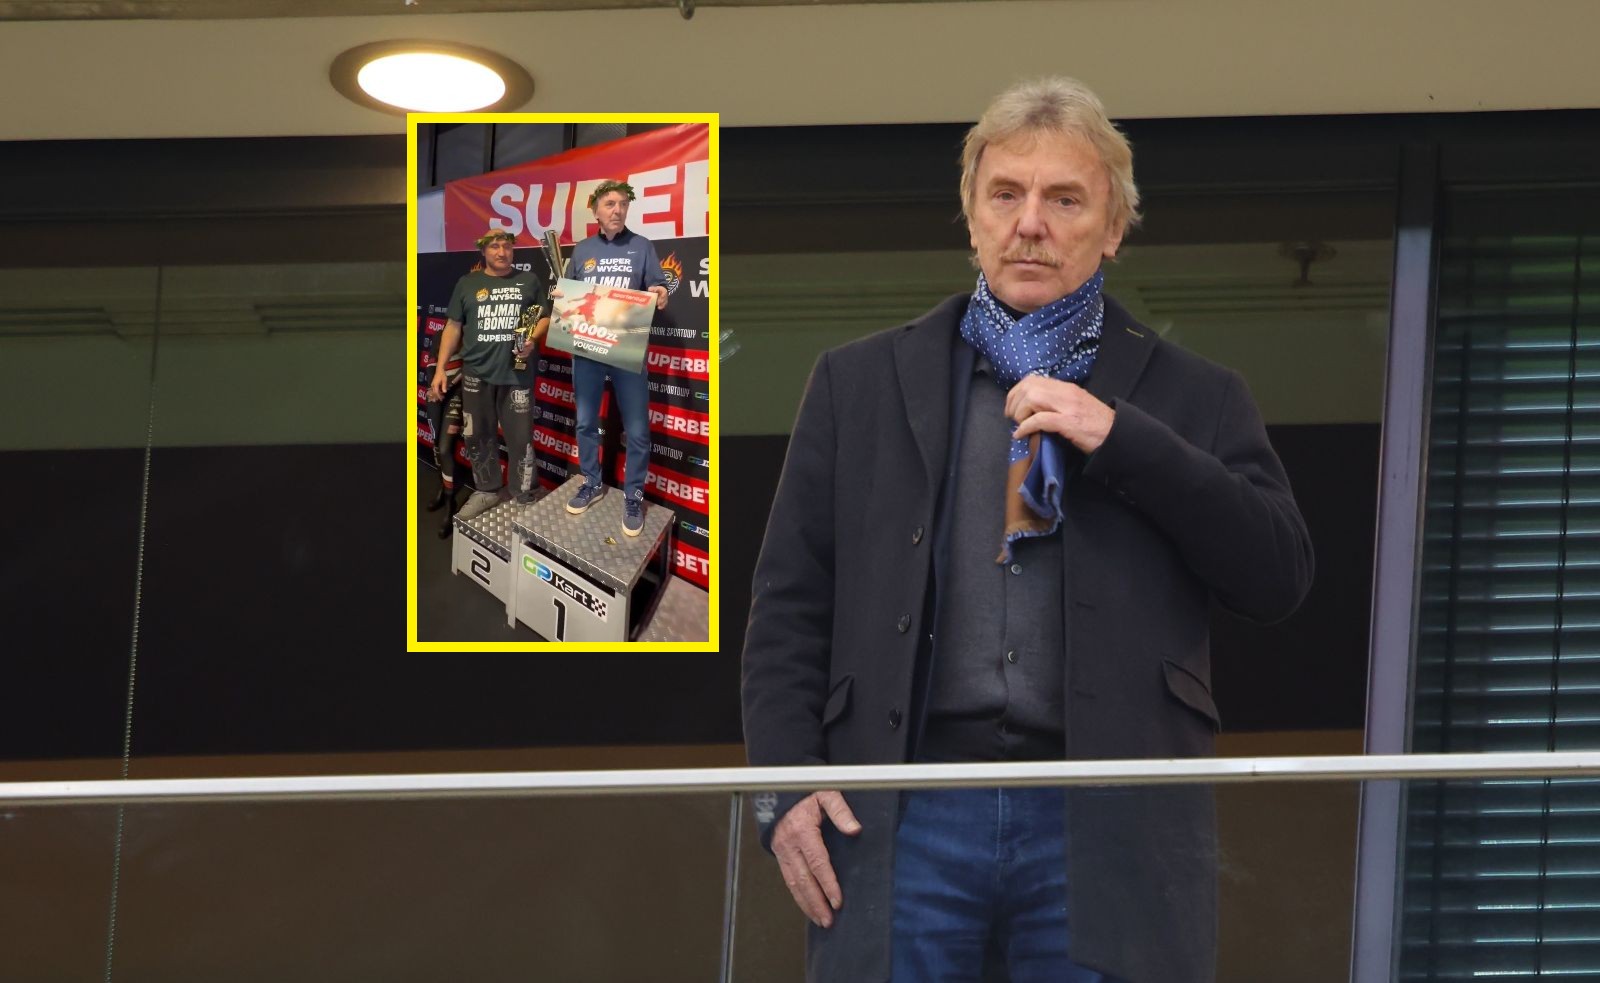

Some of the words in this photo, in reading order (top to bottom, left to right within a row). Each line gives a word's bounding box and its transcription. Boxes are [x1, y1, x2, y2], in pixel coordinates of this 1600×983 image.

[597, 264, 632, 273] WYŚCIG
[600, 257, 631, 266] SUPER
[490, 293, 522, 301] WYŚCIG
[478, 304, 521, 318] NAJMAN
[483, 317, 520, 331] BONIEK
[572, 319, 606, 338] 1000
[573, 339, 609, 355] VOUCHER
[648, 352, 709, 373] UPERB
[533, 429, 579, 458] SUPERB
[471, 549, 491, 586] 2
[554, 577, 588, 605] Kart
[553, 597, 567, 642] 1
